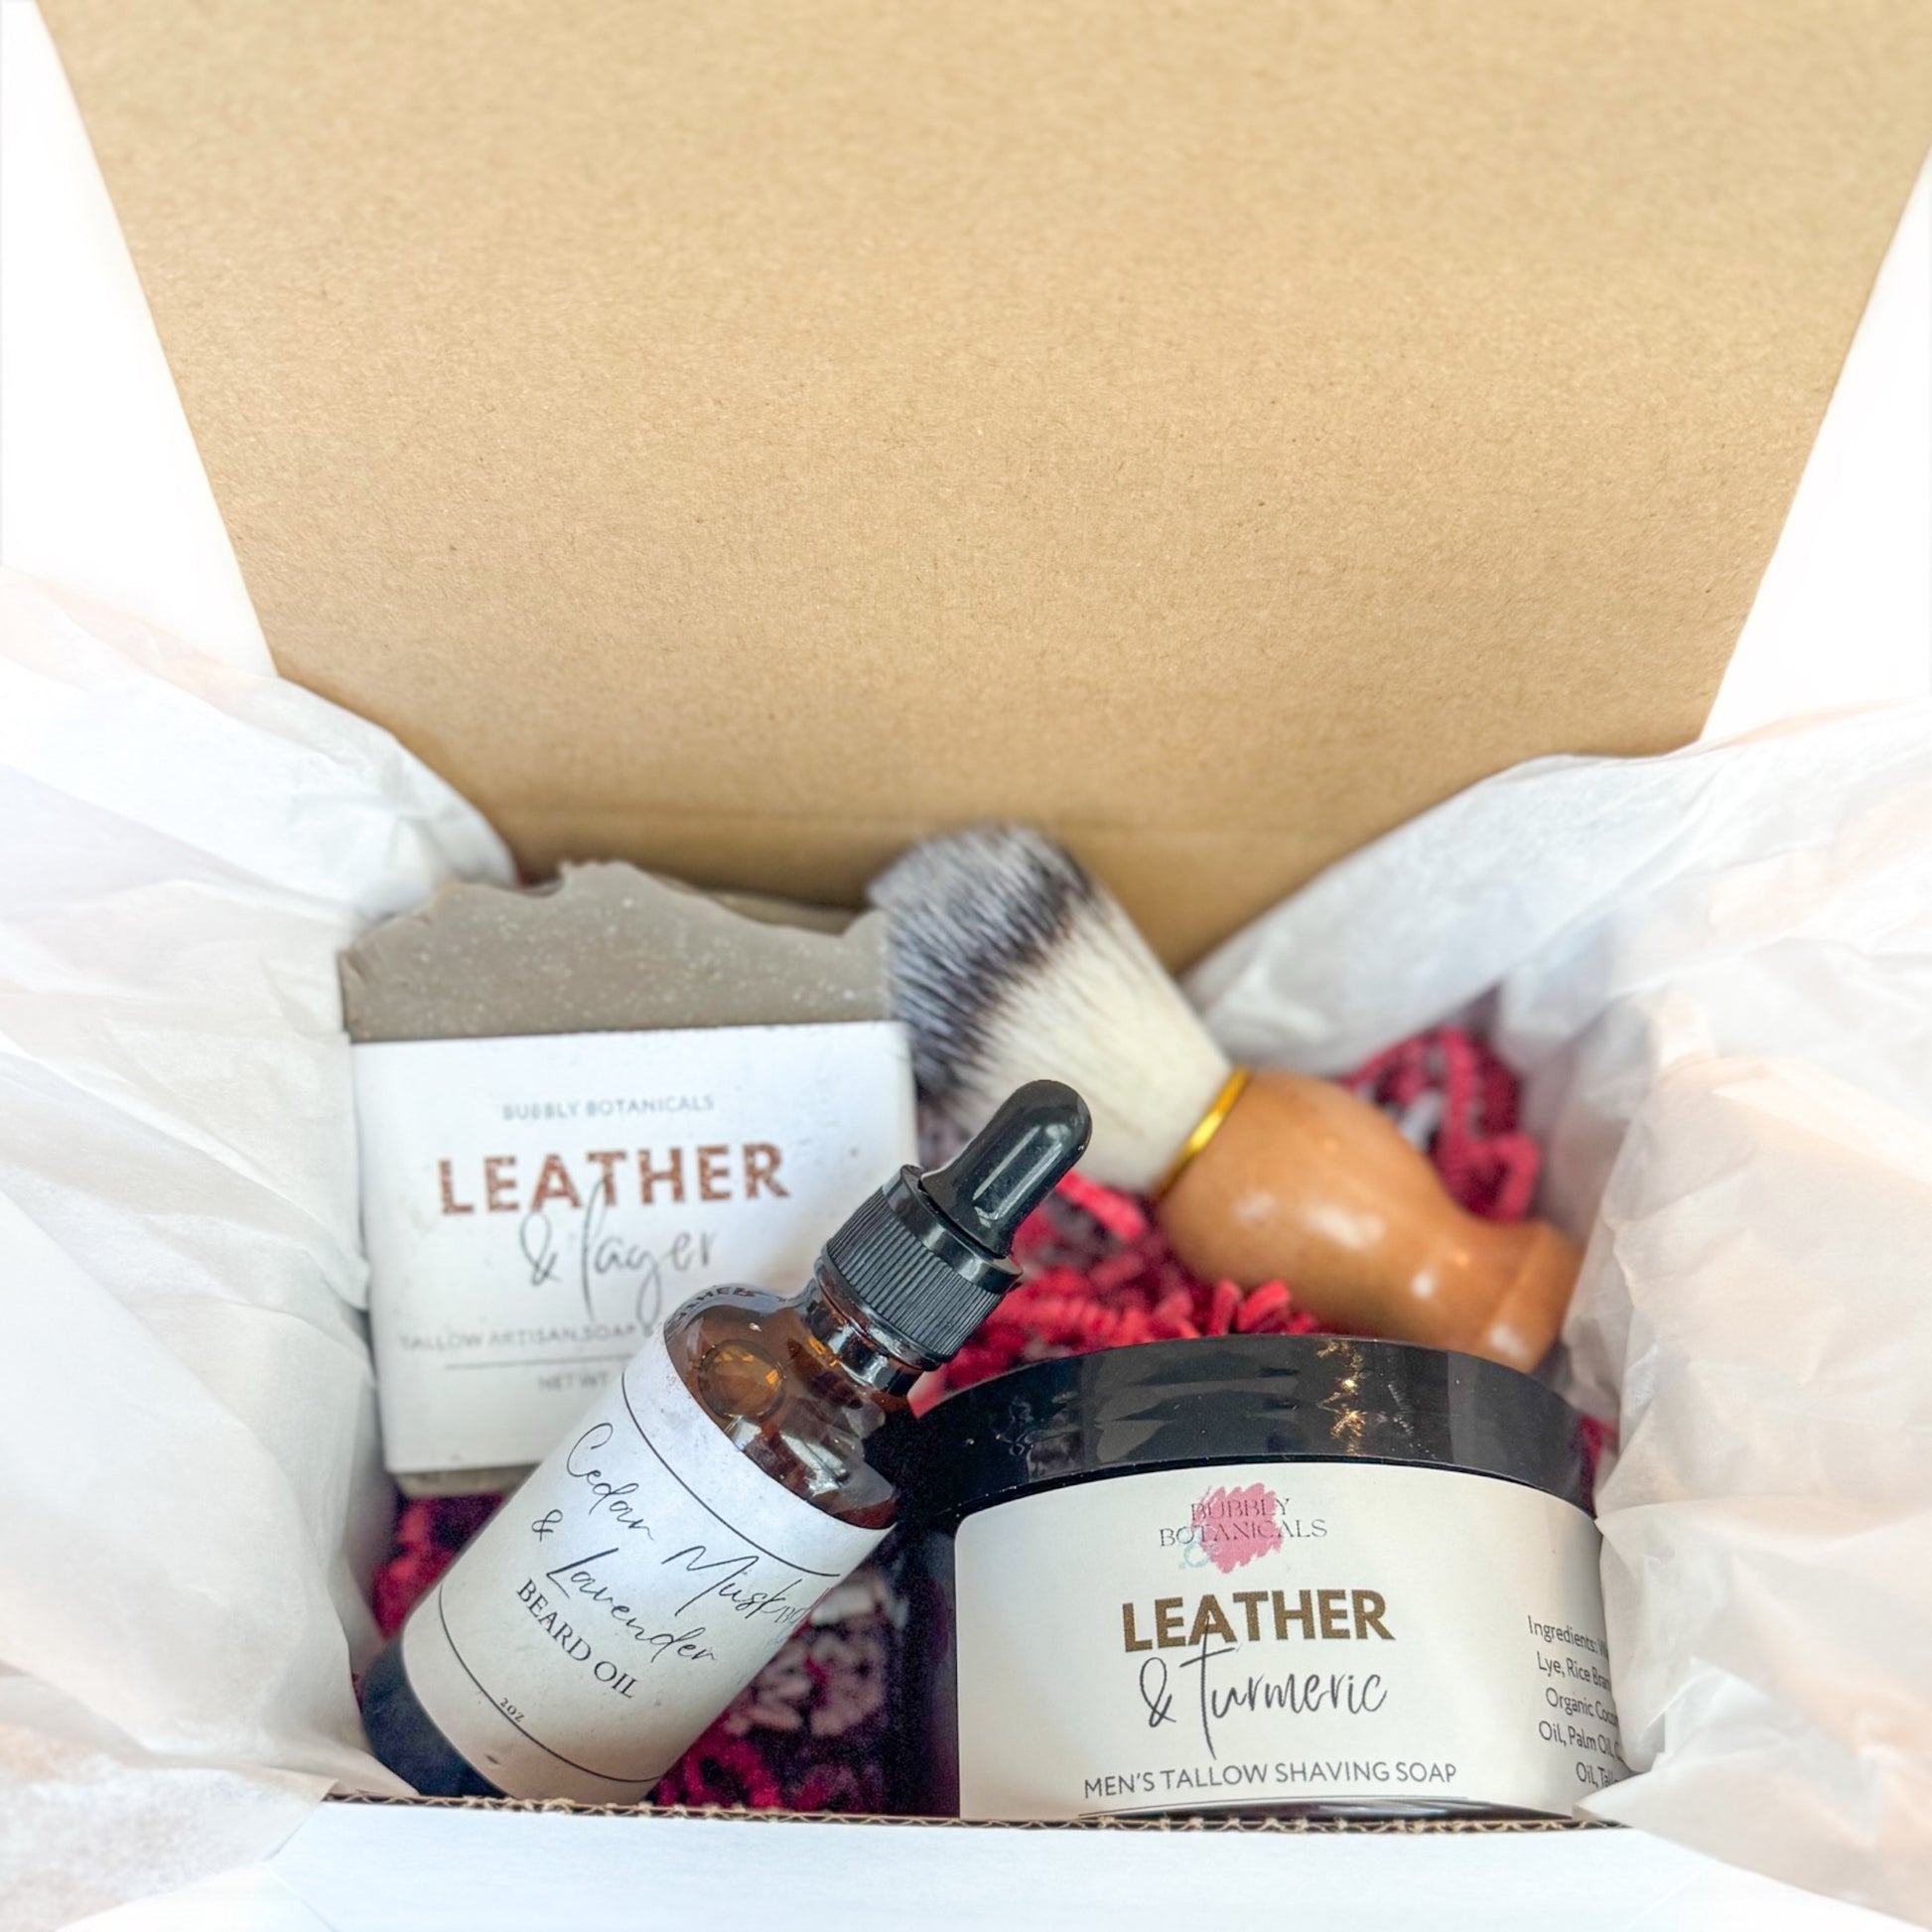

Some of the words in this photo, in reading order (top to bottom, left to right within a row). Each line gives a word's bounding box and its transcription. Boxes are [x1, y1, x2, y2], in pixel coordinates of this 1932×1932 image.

[502, 1100, 579, 1121] BUBBLY
[585, 1094, 715, 1118] BOTANICALS
[438, 1142, 791, 1216] LEATHER
[519, 1209, 561, 1287] &
[488, 1325, 572, 1347] ARTISAN
[583, 1322, 636, 1340] SOAP
[531, 1508, 563, 1542] &
[566, 1422, 654, 1541] Cedar
[660, 1545, 803, 1619] Musk
[1190, 1496, 1291, 1523] BUBBLY
[1159, 1518, 1328, 1548] BOTANICALS
[545, 1547, 718, 1663] Lavender
[1122, 1588, 1396, 1653] LEATHER
[516, 1579, 592, 1665] BEARD
[593, 1659, 637, 1700] OIL
[1527, 1614, 1598, 1655] Ingredients:
[1536, 1650, 1566, 1678] Lye,
[1566, 1657, 1591, 1683] Rice
[1138, 1655, 1177, 1728] &
[1545, 1686, 1594, 1717] Organic
[1538, 1720, 1567, 1747] Oil,
[1568, 1725, 1597, 1751] Palm
[1083, 1771, 1156, 1799] MEN'S
[1160, 1762, 1269, 1791] TALLOW
[1275, 1760, 1390, 1784] SHAVING
[1395, 1761, 1457, 1784] SOAP
